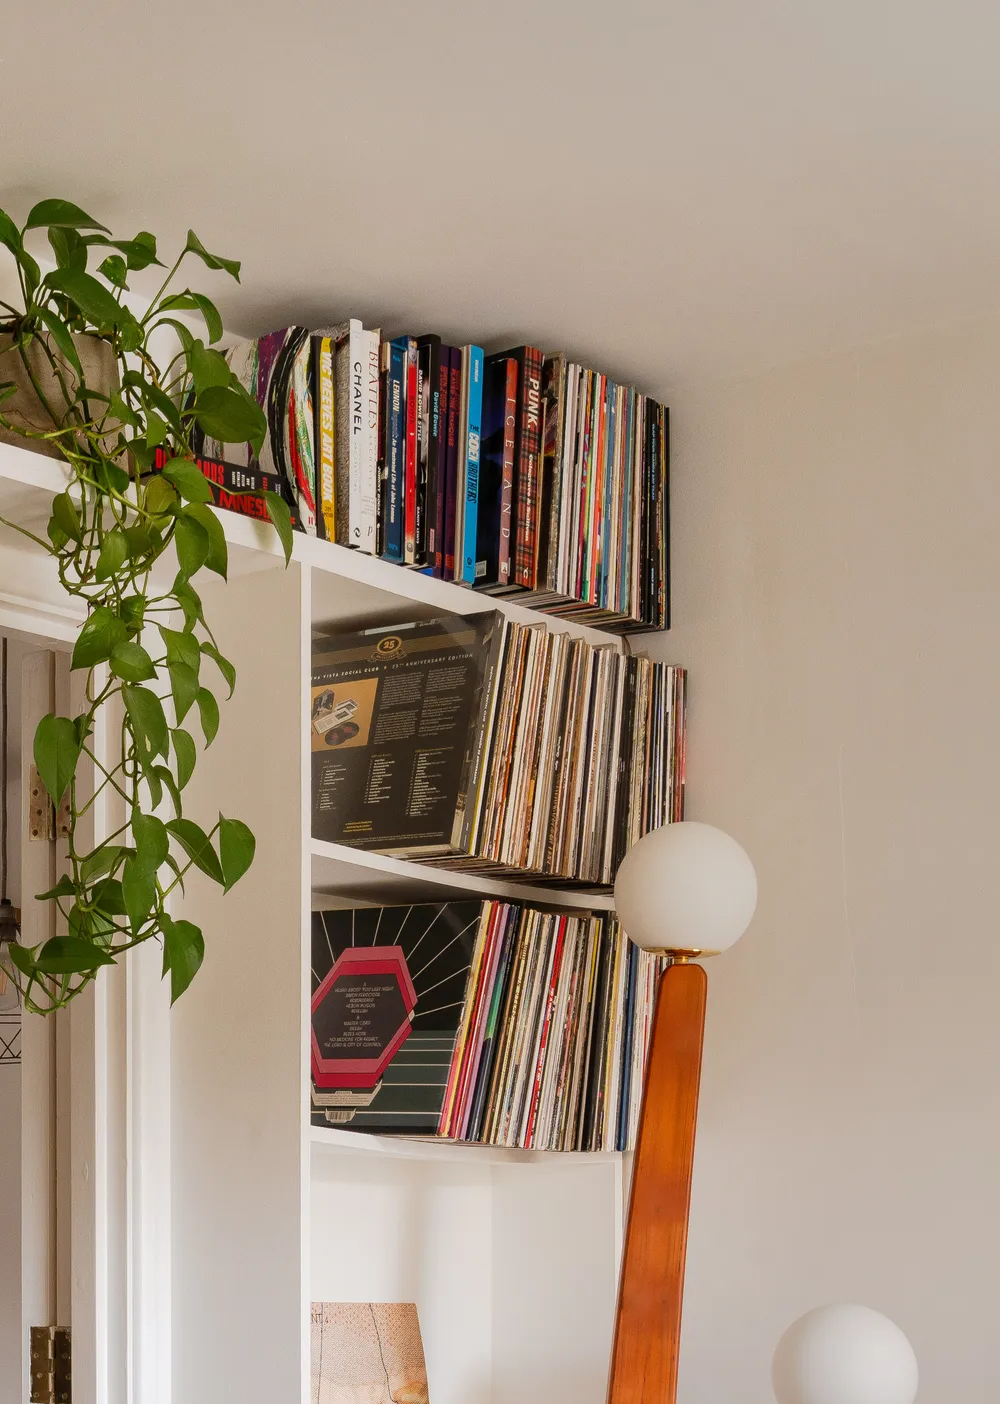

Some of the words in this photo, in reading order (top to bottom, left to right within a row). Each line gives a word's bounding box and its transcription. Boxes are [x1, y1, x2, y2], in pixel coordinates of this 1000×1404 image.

[322, 352, 332, 374] VIC
[322, 378, 332, 430] REEVES
[354, 362, 362, 435] CHANEL
[368, 351, 378, 430] BEATLES
[526, 378, 540, 429] PUNK.
[322, 432, 332, 462] ART
[468, 432, 479, 462] COEN
[469, 424, 479, 432] THE
[322, 464, 334, 502] BOOK
[466, 462, 478, 504] BROTHERS
[502, 397, 516, 538] ICELAND
[383, 640, 395, 649] 25
